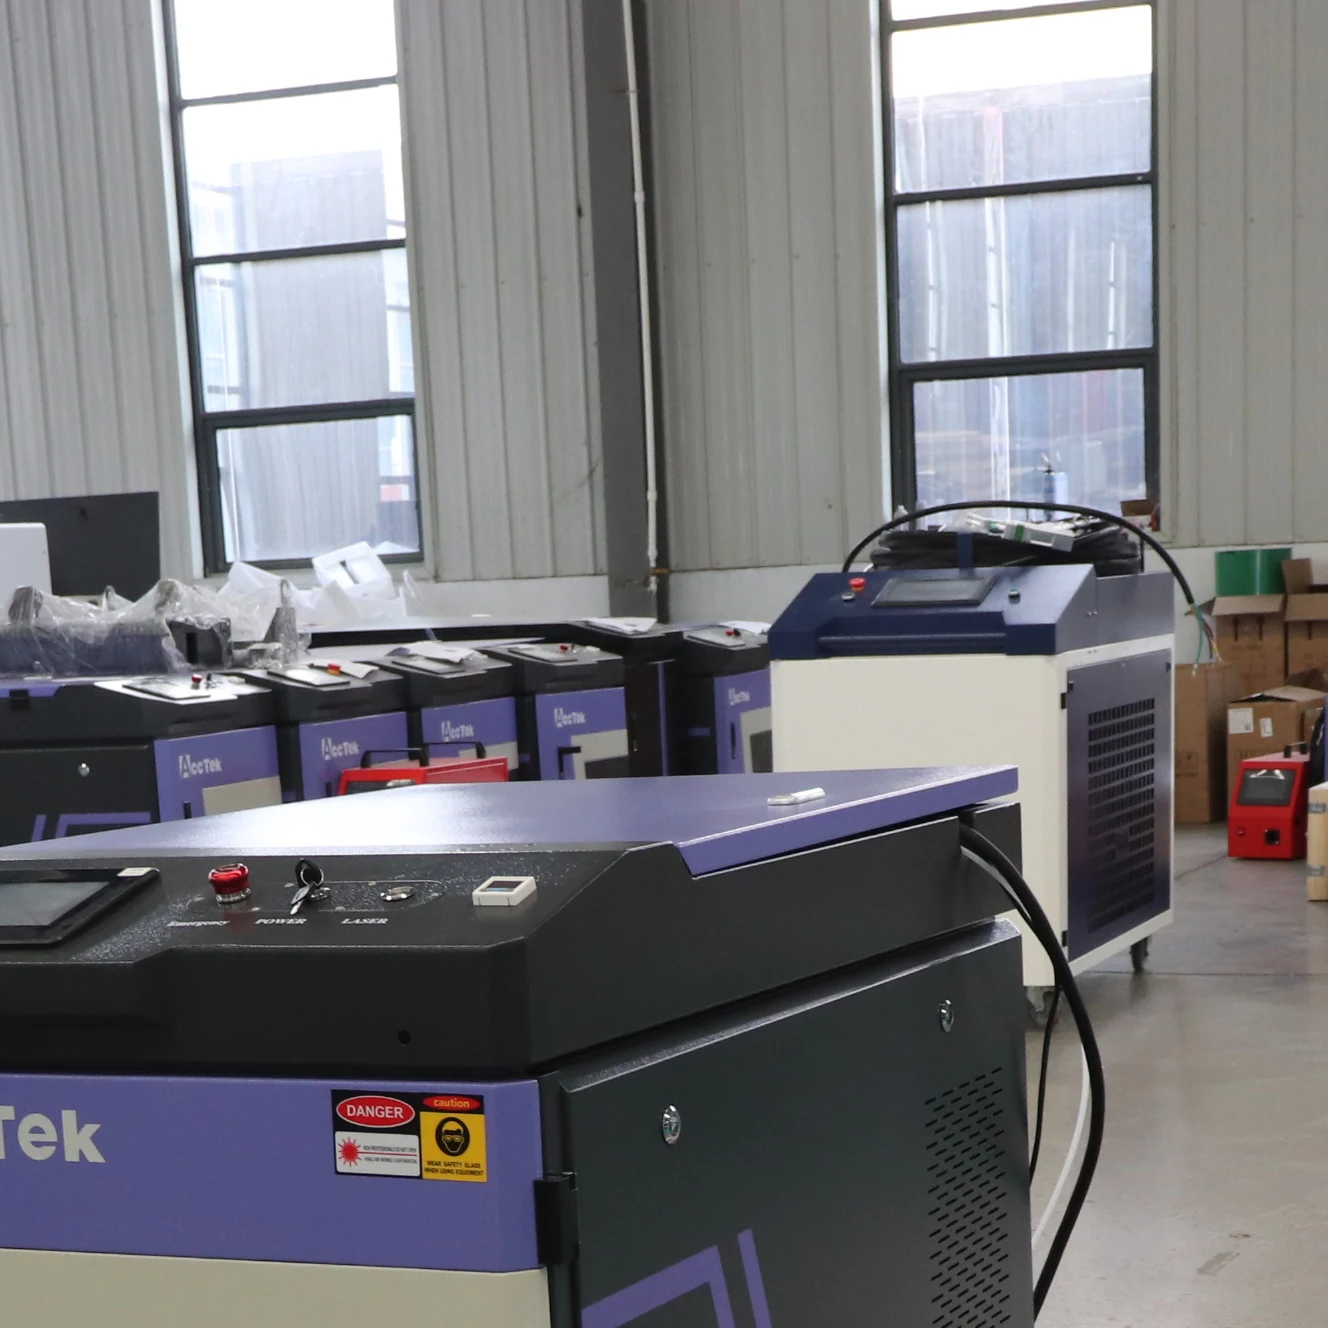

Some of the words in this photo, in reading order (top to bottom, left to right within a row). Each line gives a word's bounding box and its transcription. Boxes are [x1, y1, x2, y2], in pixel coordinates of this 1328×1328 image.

[321, 737, 360, 760] AccTek
[178, 754, 222, 778] AccTek
[346, 1104, 404, 1119] DANGER
[433, 1097, 470, 1108] caution
